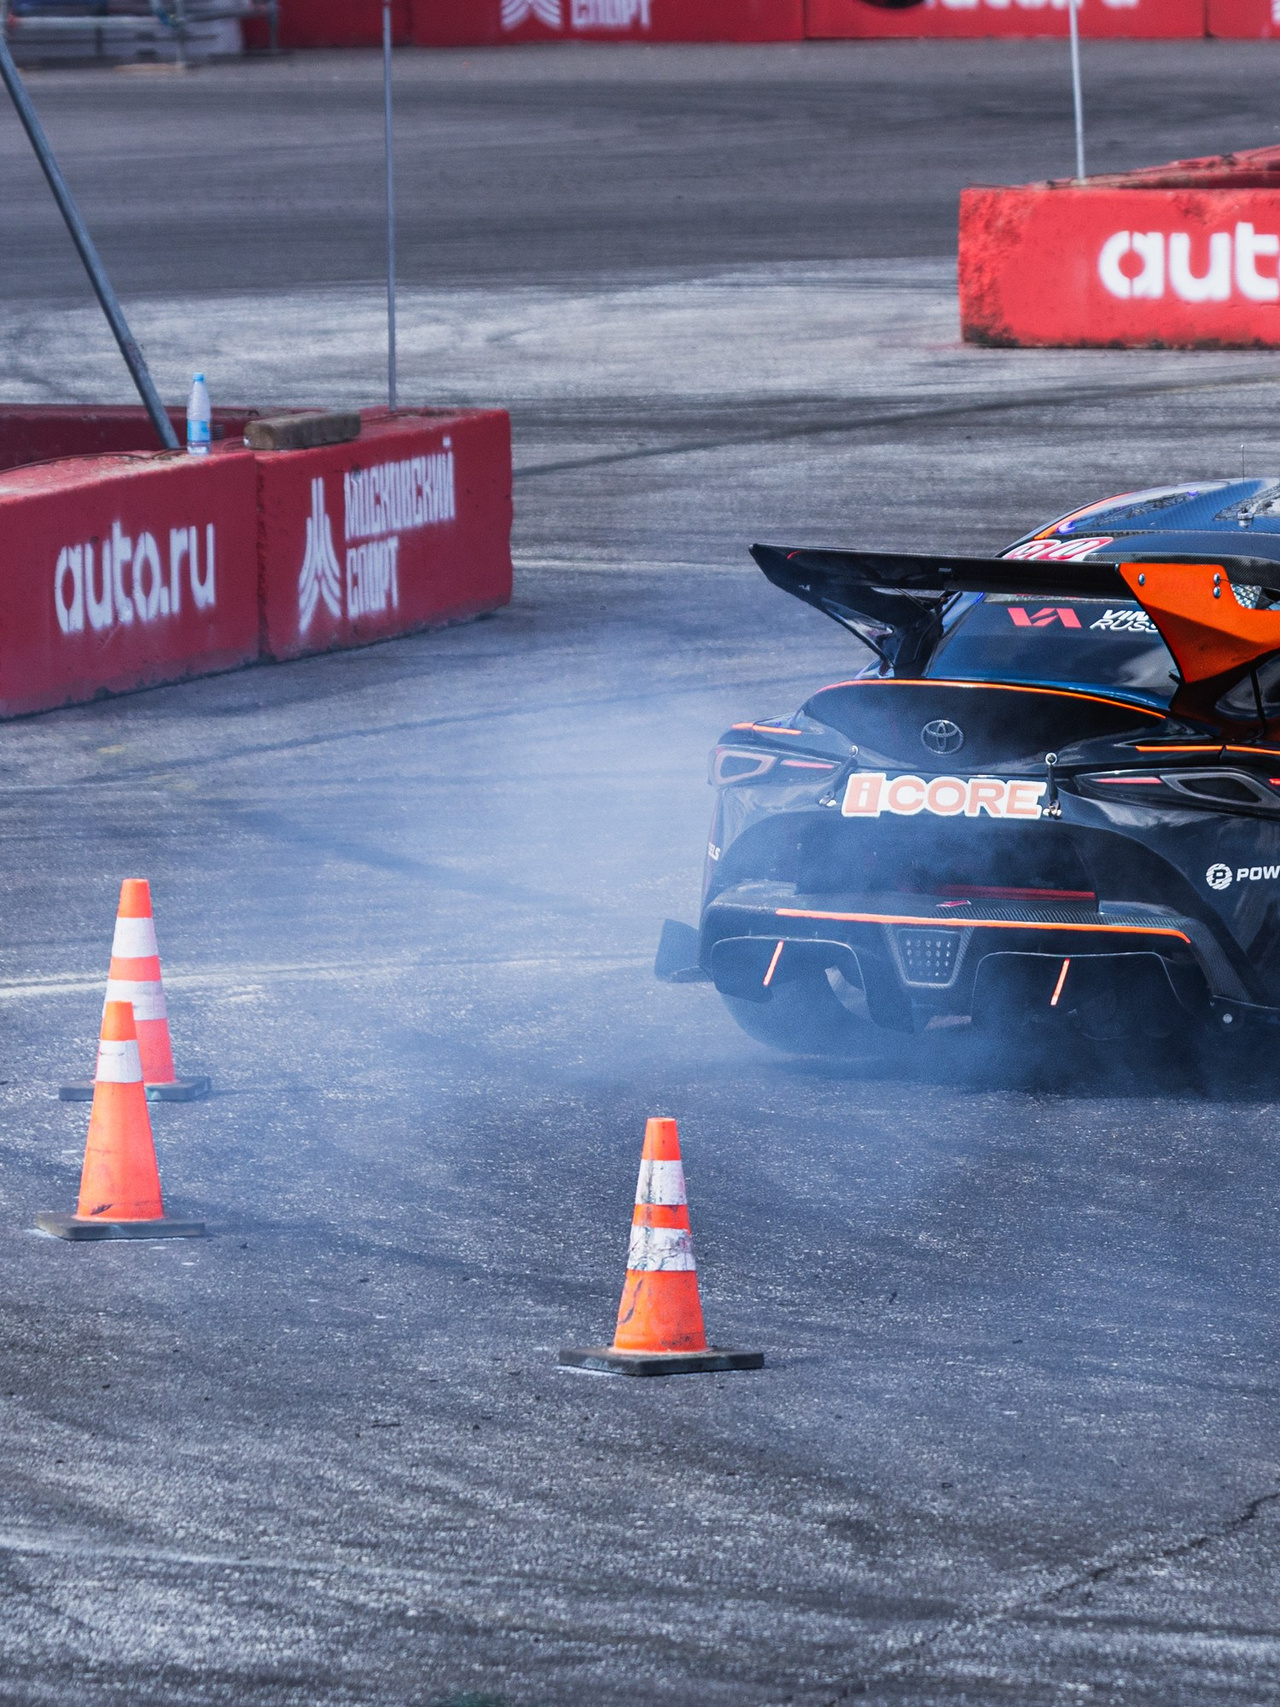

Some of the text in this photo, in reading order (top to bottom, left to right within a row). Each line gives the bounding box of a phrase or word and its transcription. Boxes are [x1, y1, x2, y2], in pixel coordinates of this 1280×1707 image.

[344, 436, 456, 541] МОСКОВСКИЙ
[54, 519, 215, 635] auto.ru
[346, 535, 399, 620] СПОРТ
[1102, 609, 1150, 621] VIN
[1089, 619, 1159, 634] RUSS
